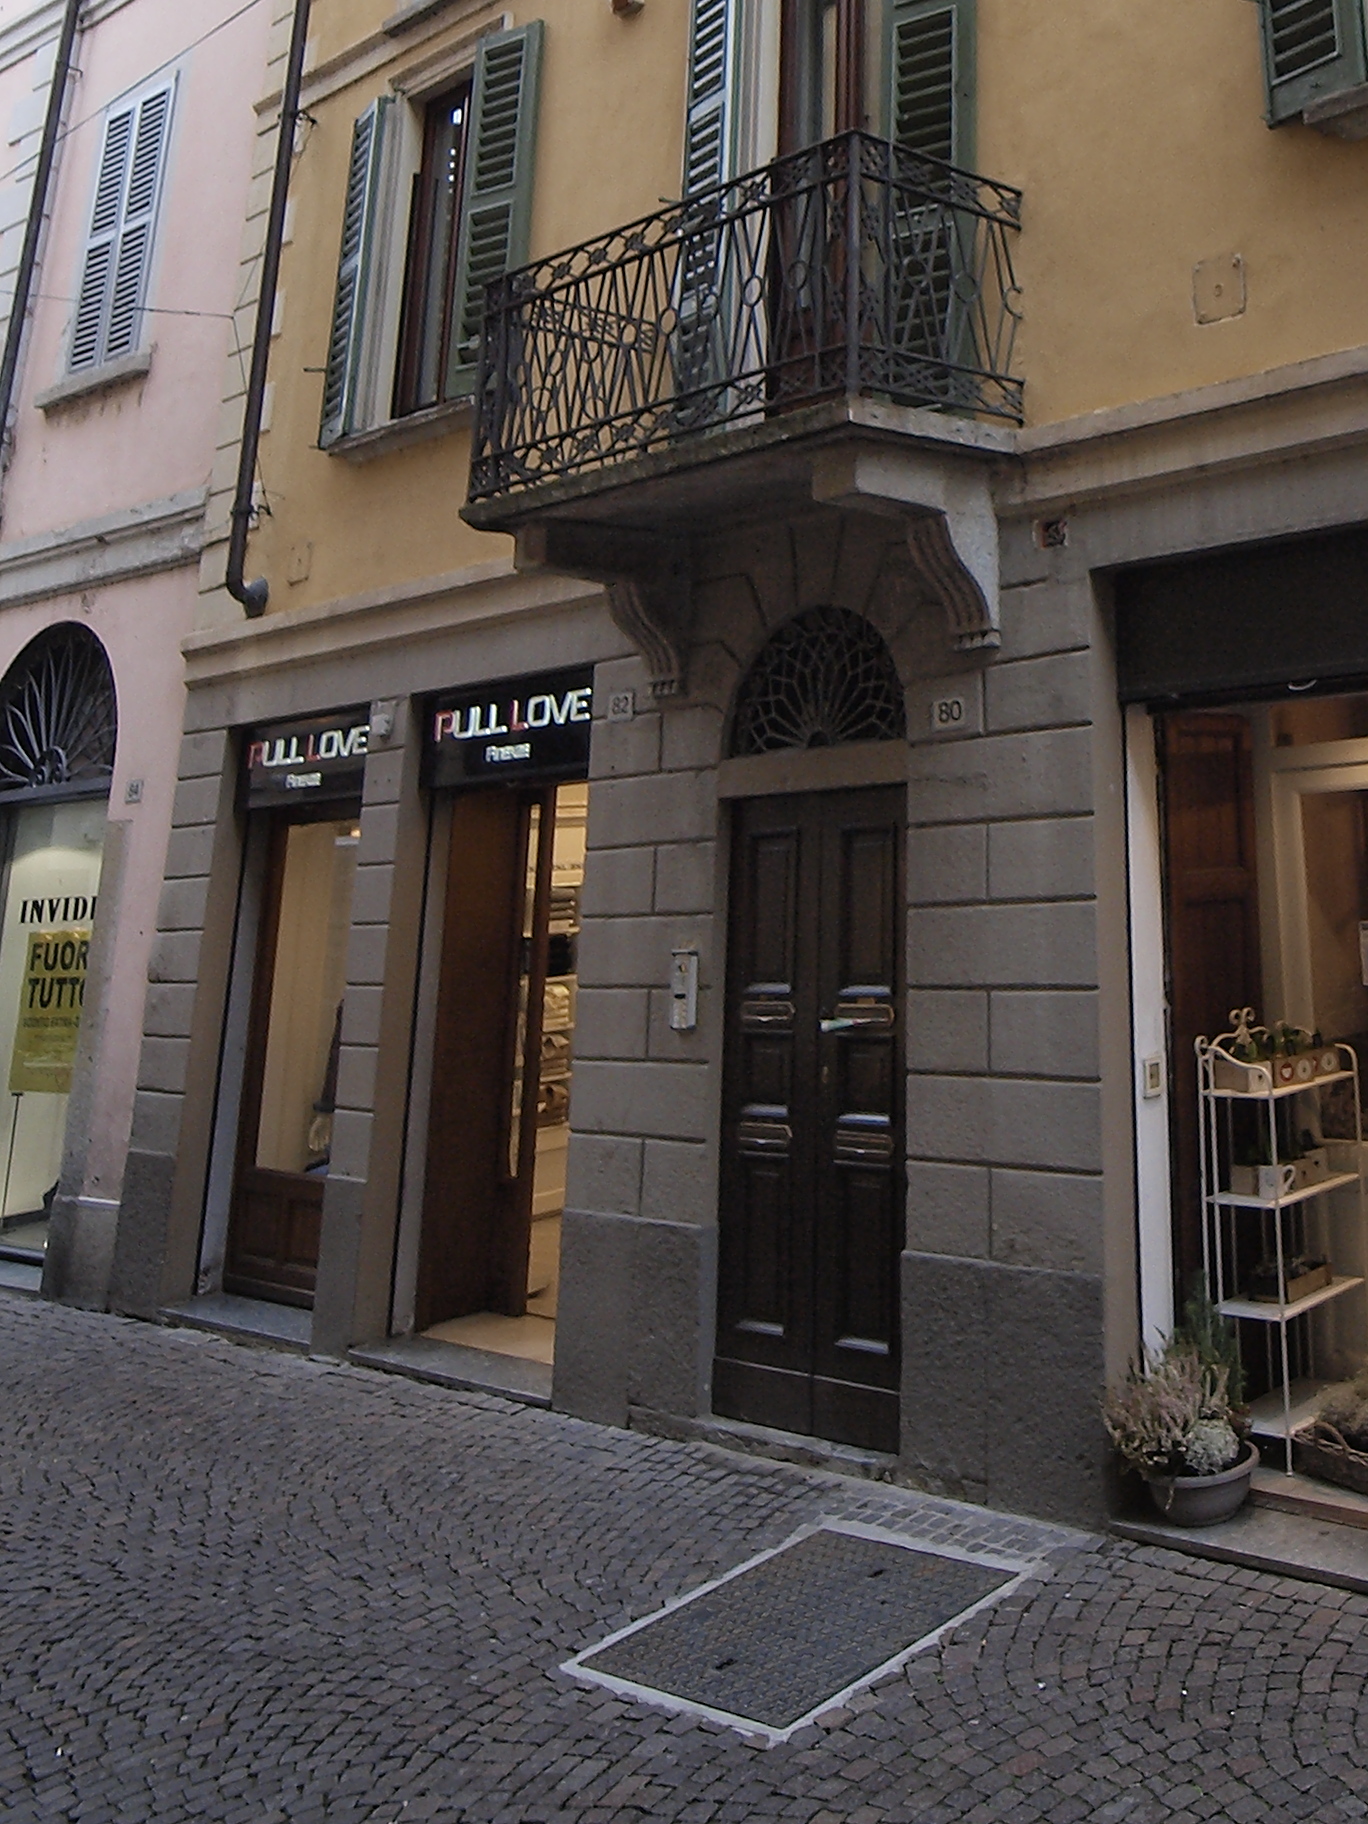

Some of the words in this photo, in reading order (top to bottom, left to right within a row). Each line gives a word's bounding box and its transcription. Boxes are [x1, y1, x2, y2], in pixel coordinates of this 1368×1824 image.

[434, 703, 508, 742] PULL
[510, 687, 592, 731] LOVE
[611, 695, 629, 715] 82
[938, 700, 962, 723] 80
[247, 736, 305, 768] PULL
[305, 725, 370, 762] LOVE
